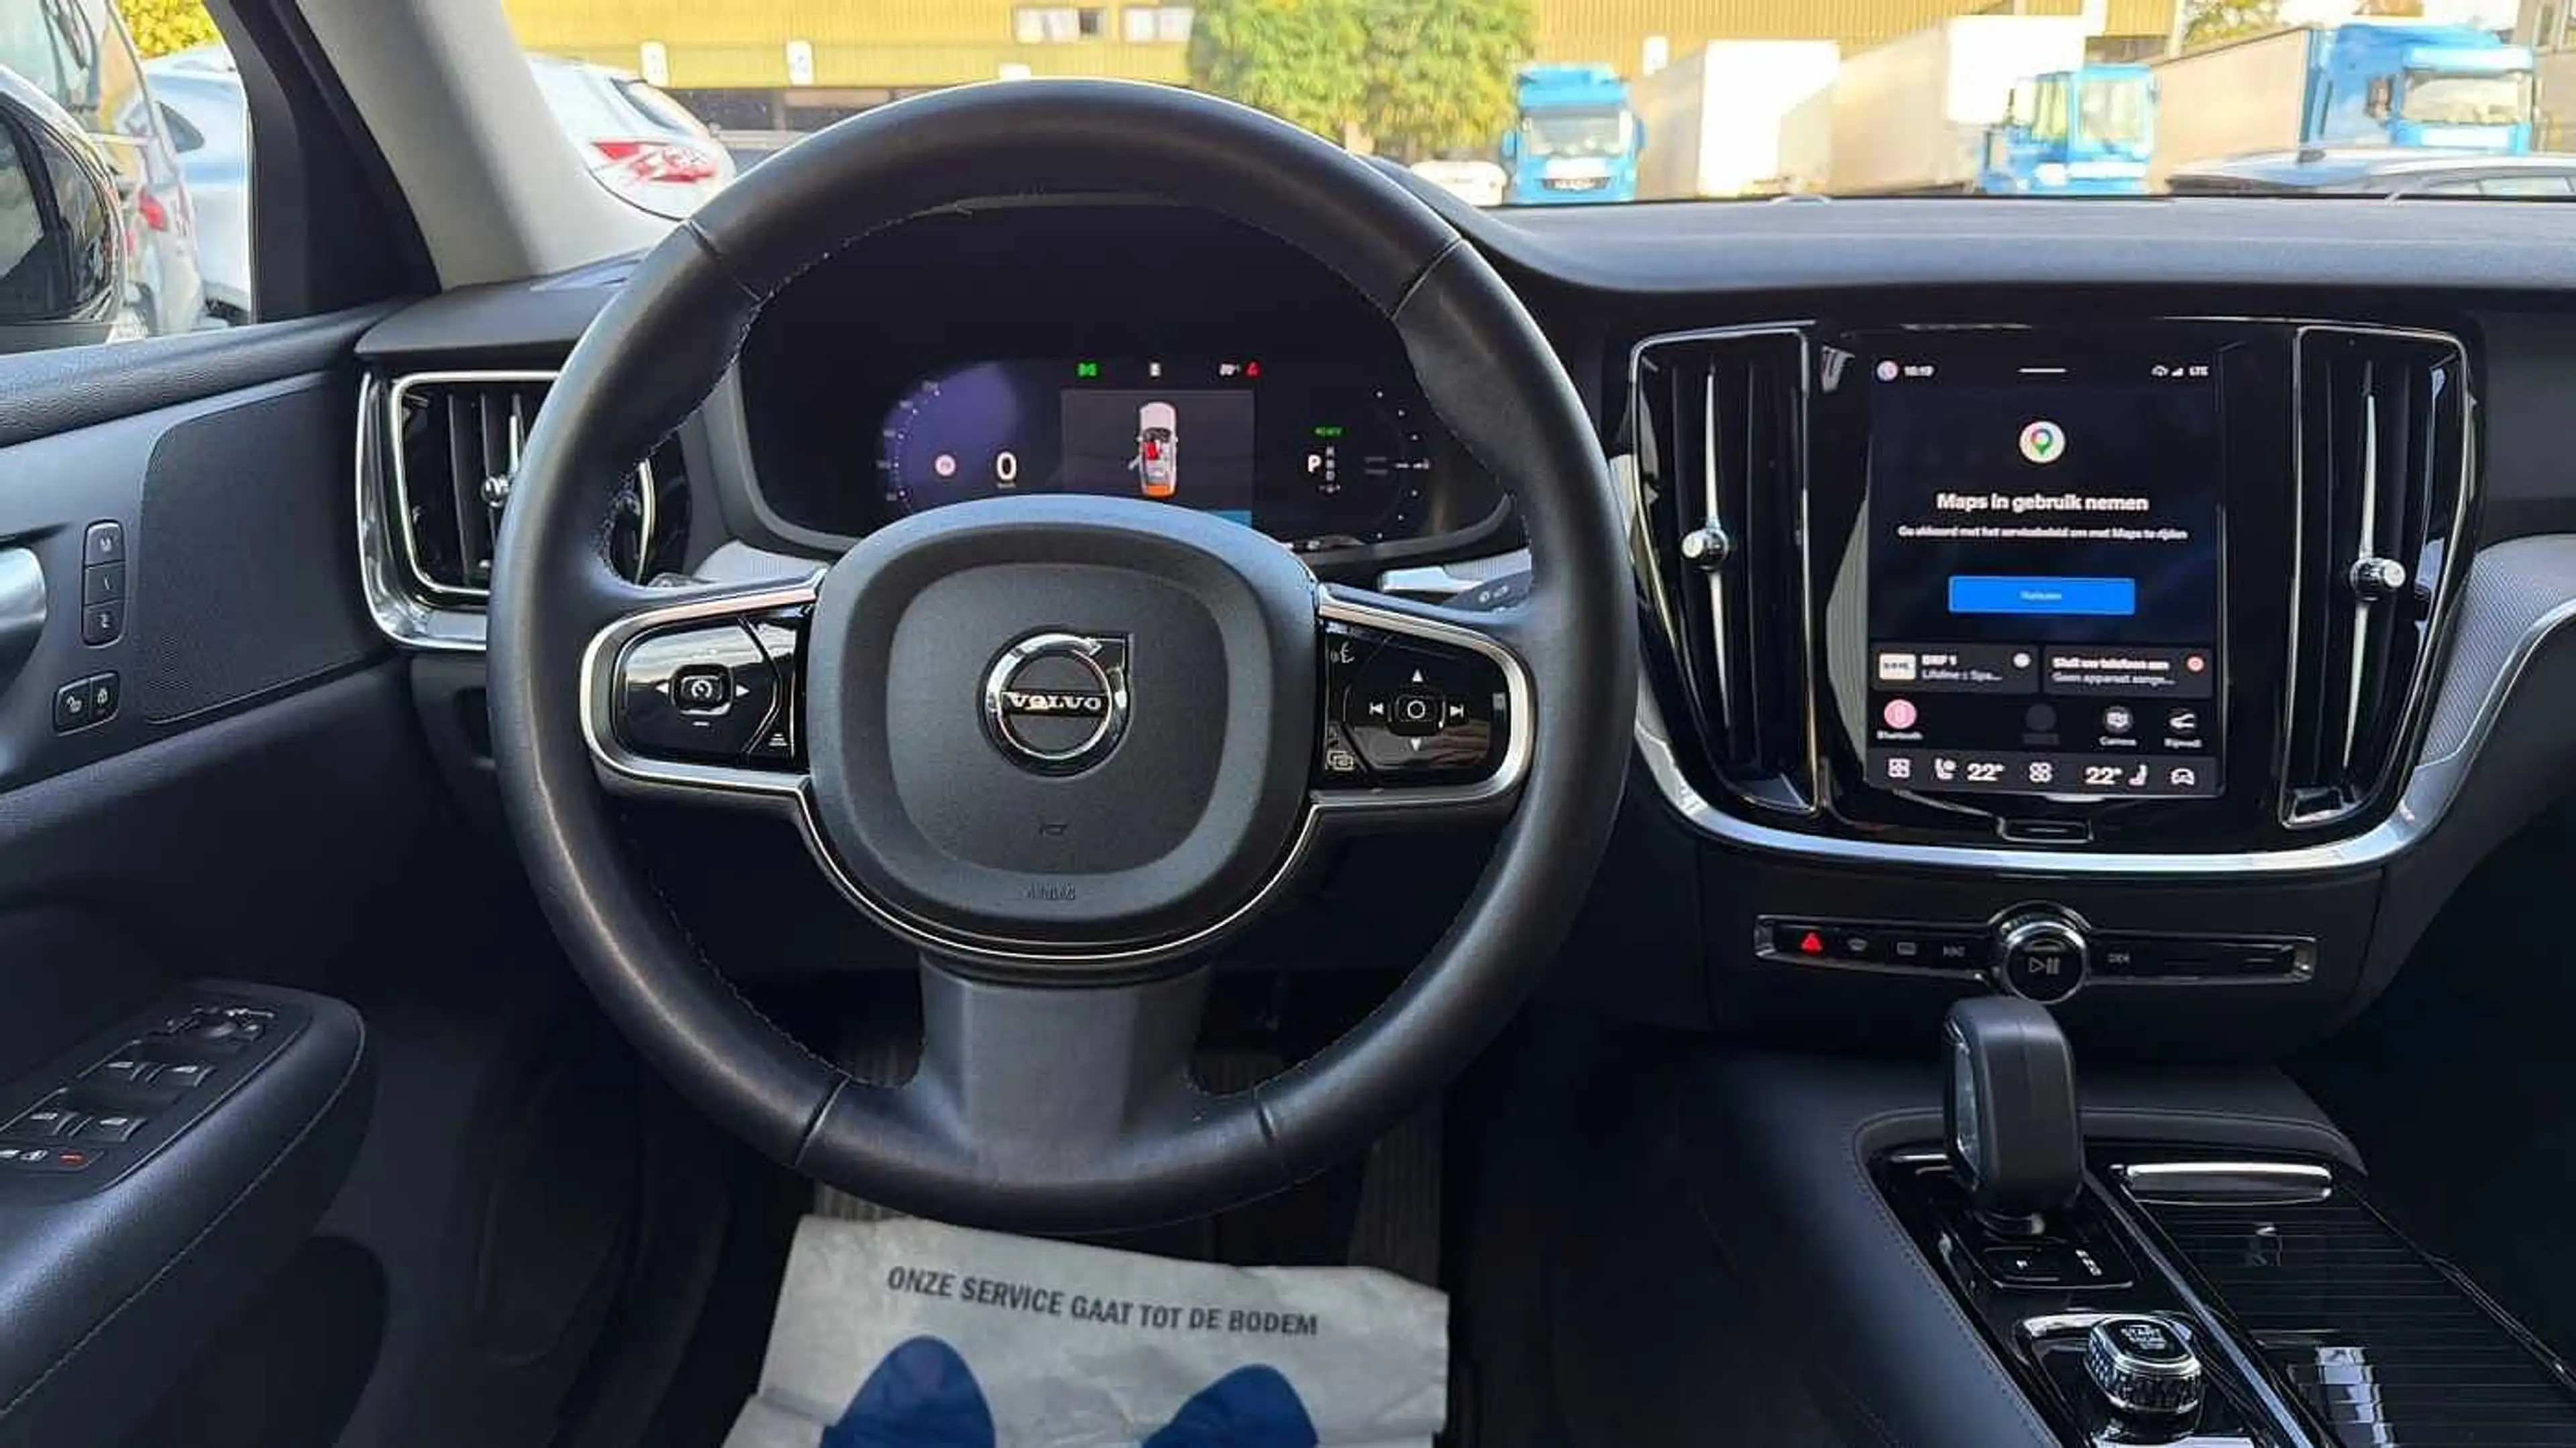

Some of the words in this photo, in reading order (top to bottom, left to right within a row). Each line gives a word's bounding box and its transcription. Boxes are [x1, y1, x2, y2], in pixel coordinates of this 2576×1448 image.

[996, 451, 1017, 480] 0
[1307, 454, 1322, 473] P
[1936, 493, 1989, 513] Maps
[1990, 493, 2010, 510] in
[2012, 493, 2082, 514] gebruik
[2084, 497, 2149, 511] nemen
[1008, 692, 1102, 711] VOLVO
[1967, 762, 2005, 782] 22°
[2085, 766, 2123, 785] 22°
[887, 1265, 957, 1297] ONZE
[959, 1276, 1065, 1316] SERVICE
[1071, 1294, 1134, 1326] GAAT
[1139, 1304, 1183, 1330] TOT
[1189, 1306, 1223, 1331] DE
[1228, 1309, 1319, 1336] BODEM
